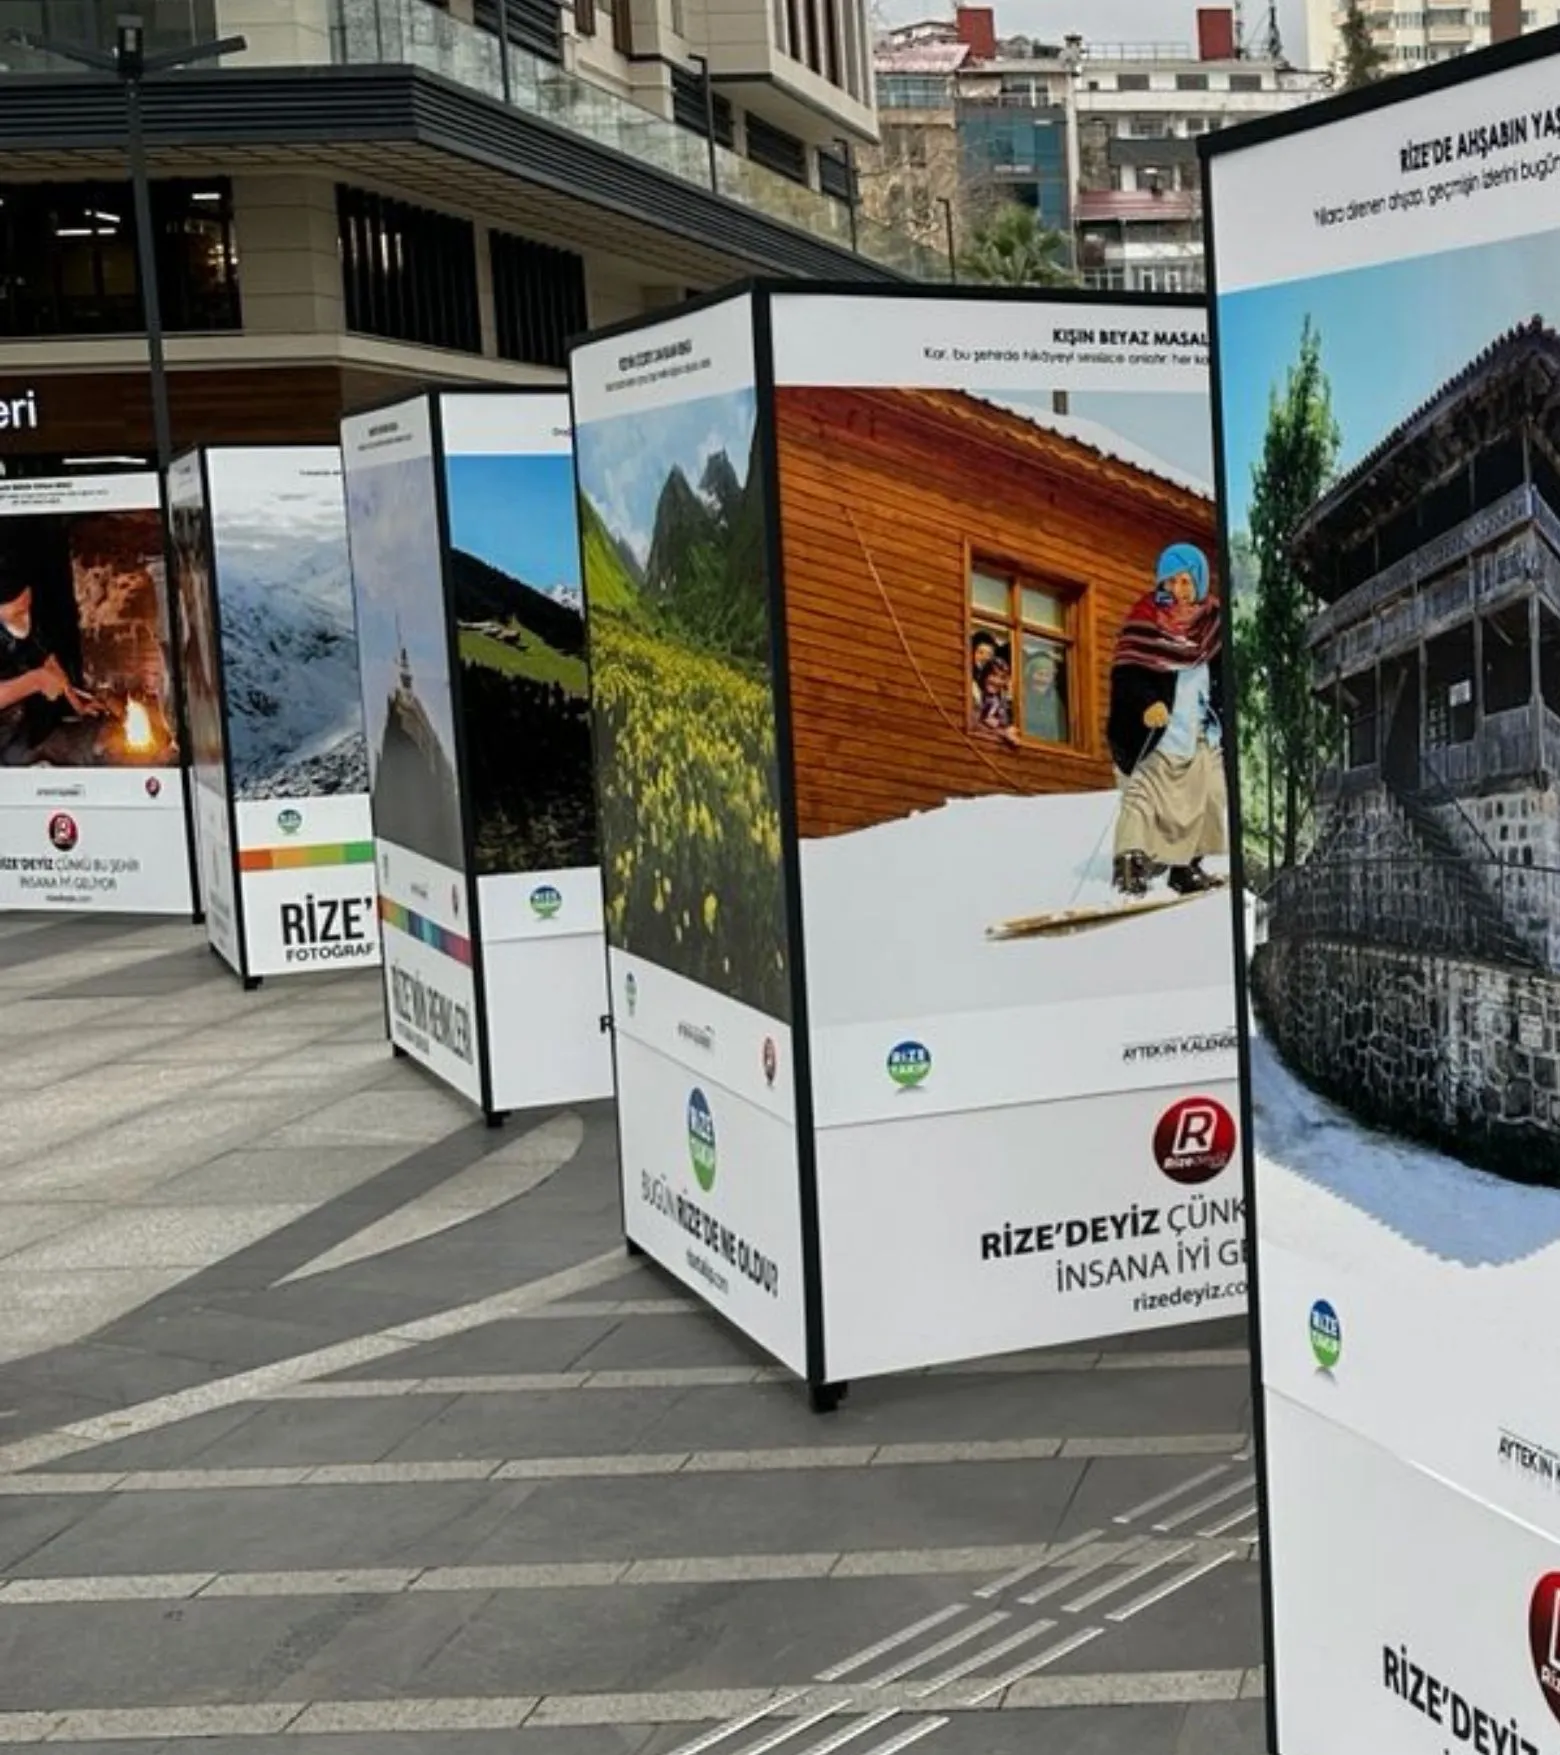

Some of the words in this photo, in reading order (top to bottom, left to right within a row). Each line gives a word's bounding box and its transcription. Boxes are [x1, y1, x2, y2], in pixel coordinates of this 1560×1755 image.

[1400, 139, 1453, 174] RİZE'DE
[1457, 116, 1528, 160] AHŞABIN
[1053, 328, 1095, 346] KIŞIN
[1100, 330, 1149, 346] BEYAZ
[981, 1204, 1160, 1260] RİZE'DEYİZ
[1056, 1250, 1170, 1293] İNSANA
[1177, 1236, 1210, 1274] İYİ
